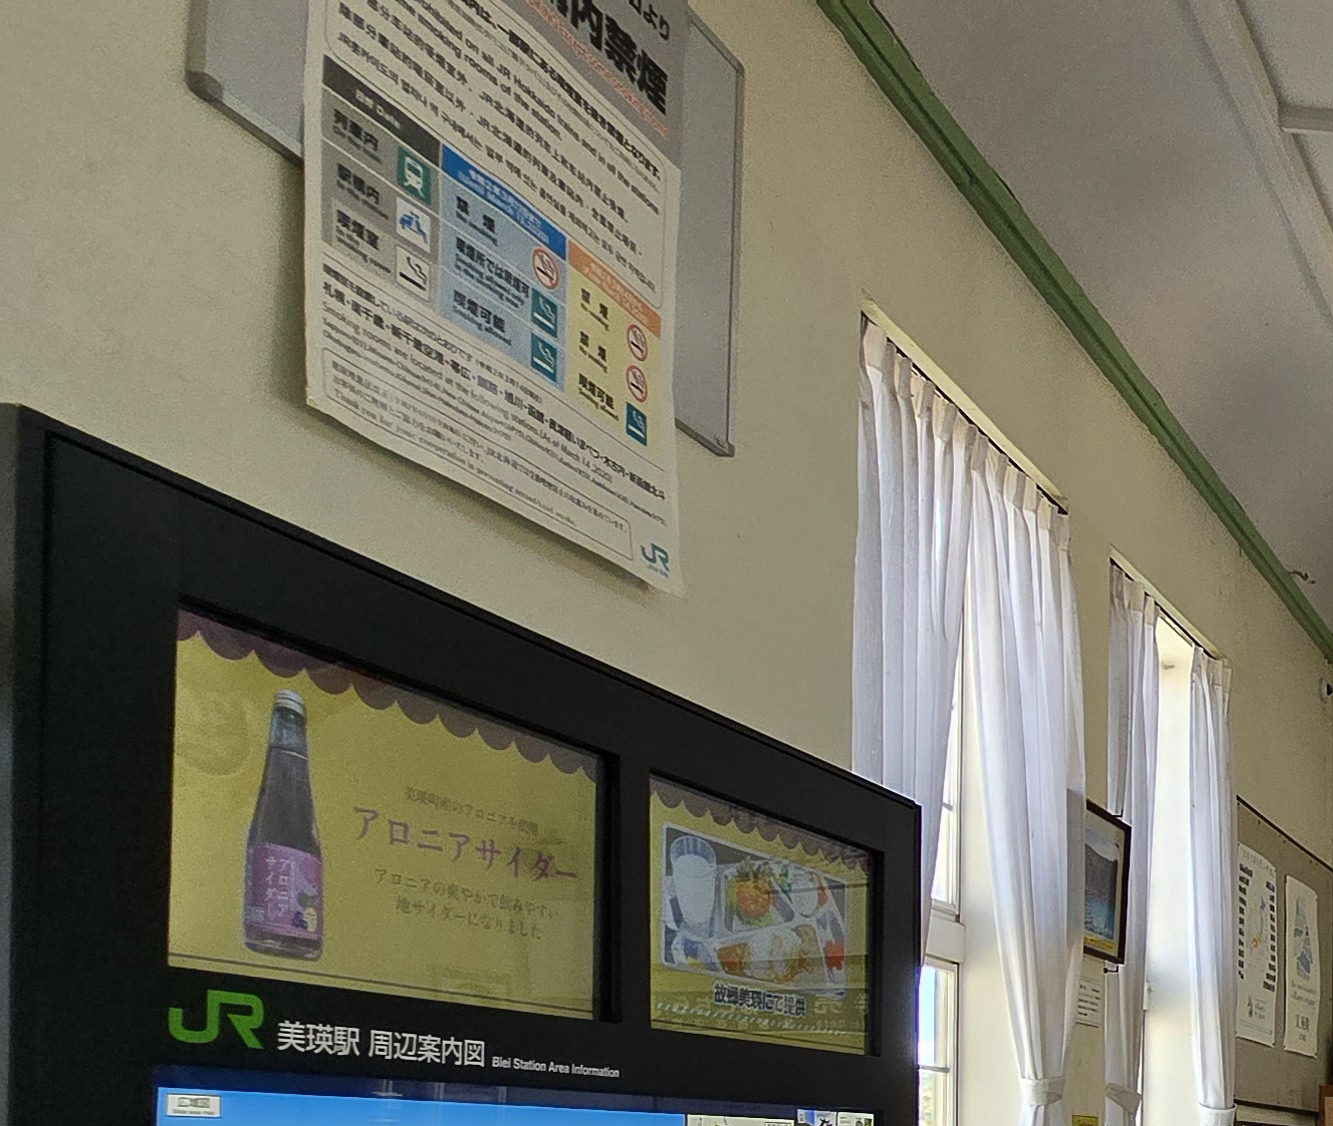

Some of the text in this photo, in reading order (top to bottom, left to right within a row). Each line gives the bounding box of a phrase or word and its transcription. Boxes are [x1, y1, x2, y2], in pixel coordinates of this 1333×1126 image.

[640, 542, 670, 573] JR
[353, 805, 578, 882] アロニアサイダー
[167, 989, 264, 1050] JR
[277, 1020, 486, 1068] 美瑛駅 周辺案内図
[491, 1056, 621, 1079] Biei Station Area Information
